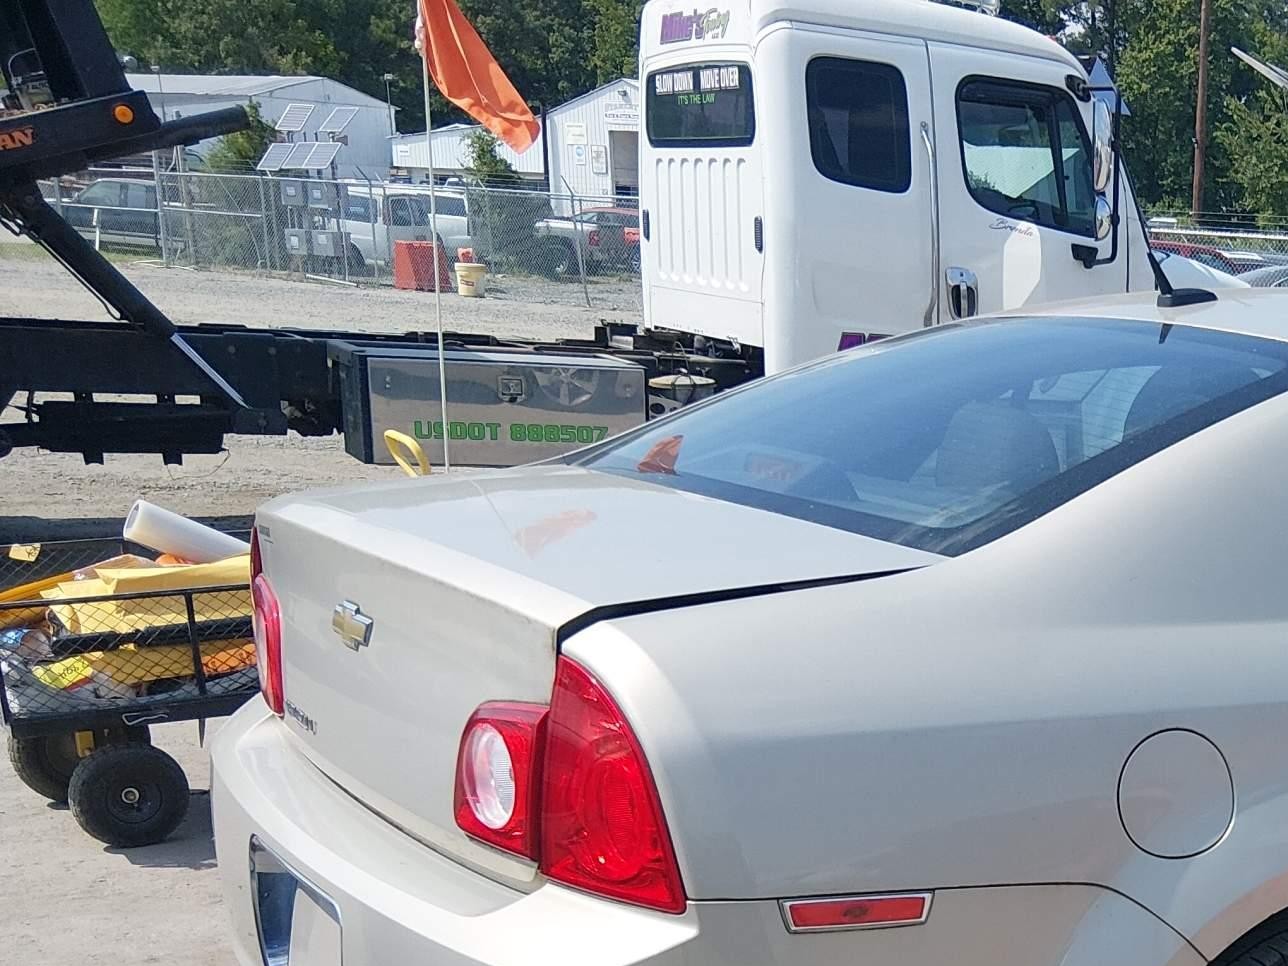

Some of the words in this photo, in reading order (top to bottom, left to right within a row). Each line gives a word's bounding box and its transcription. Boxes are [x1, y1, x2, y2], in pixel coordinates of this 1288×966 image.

[660, 9, 704, 45] Mike's
[655, 74, 673, 95] SLOW
[673, 71, 694, 93] DOWN
[700, 68, 720, 91] MOVE
[720, 66, 739, 89] OVER
[690, 95, 701, 104] THE
[702, 94, 715, 104] LAW
[414, 420, 501, 441] USDOT
[509, 423, 609, 444] 888507
